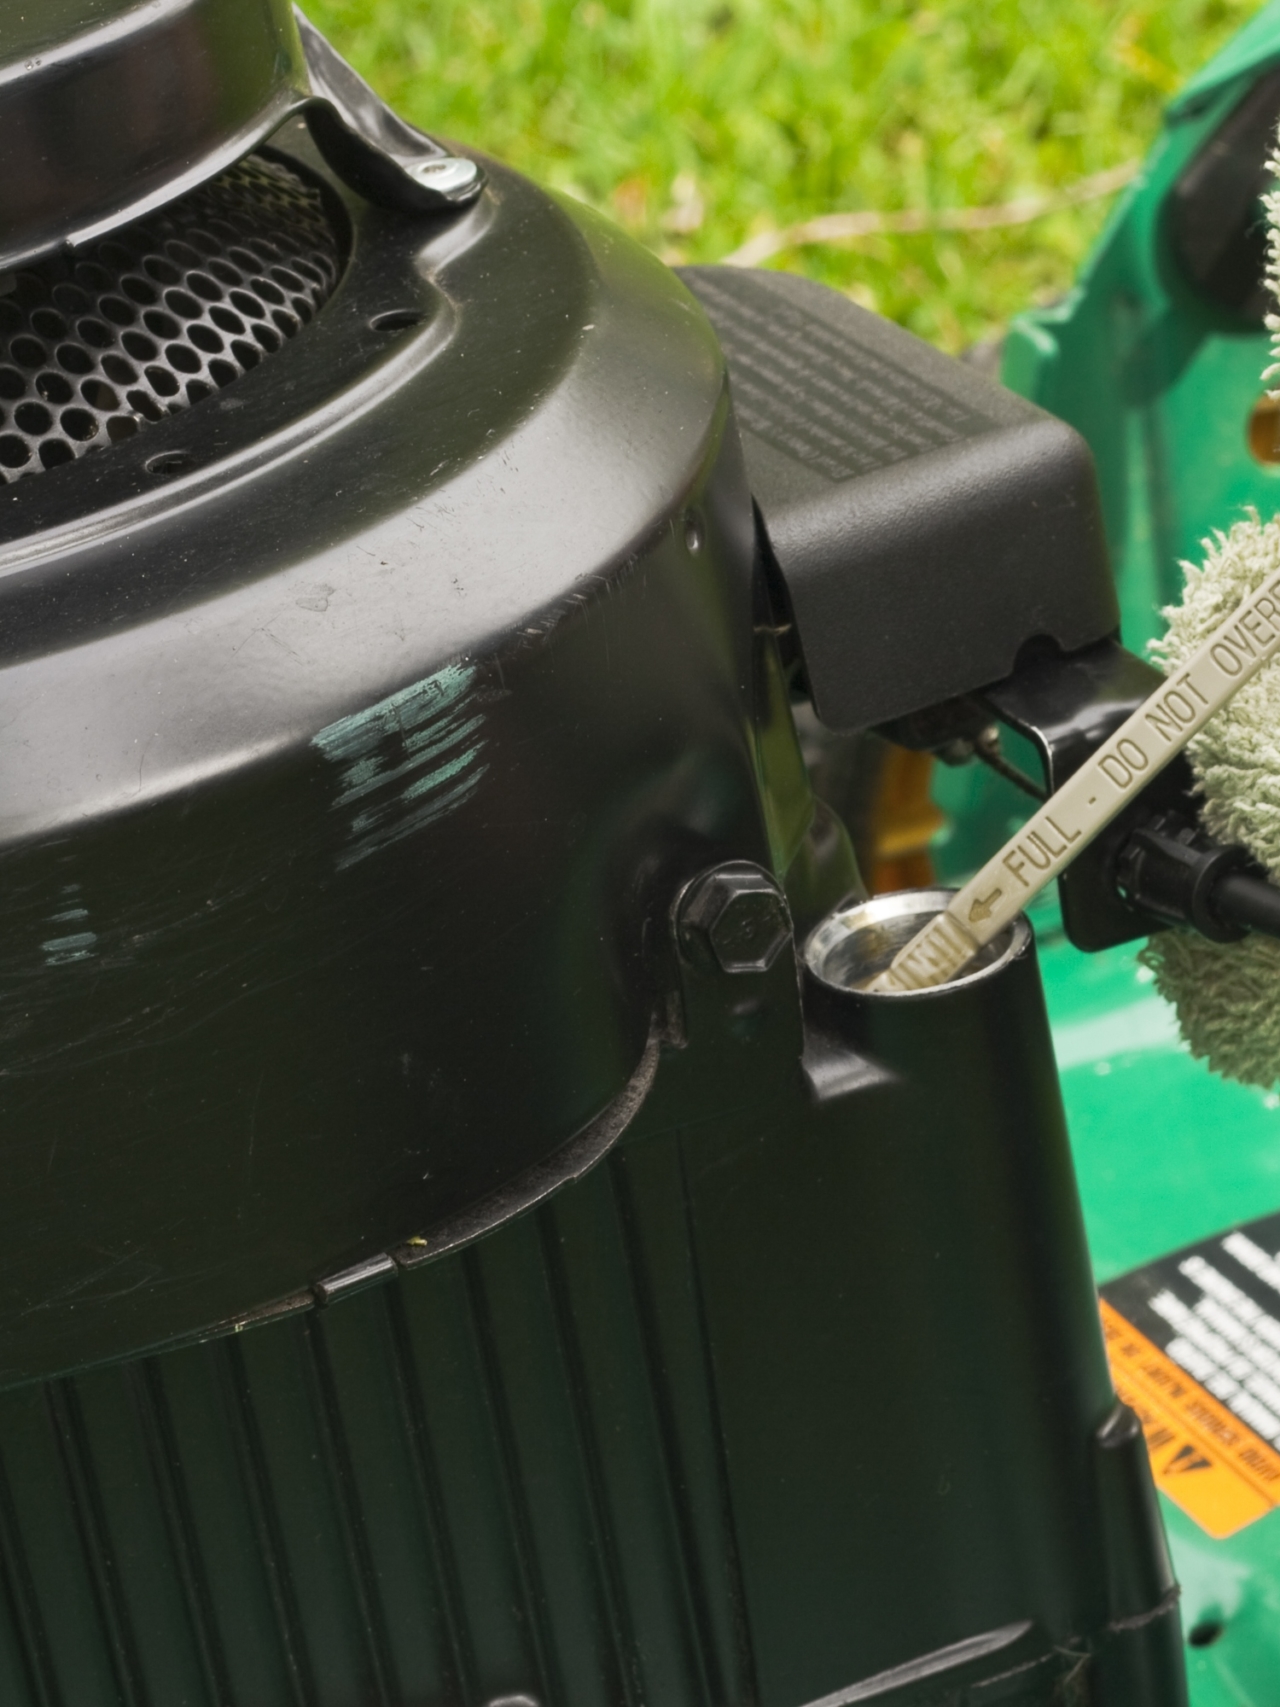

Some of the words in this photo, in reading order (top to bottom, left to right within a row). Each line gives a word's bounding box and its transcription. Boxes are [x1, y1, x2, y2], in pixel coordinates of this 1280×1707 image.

[1002, 815, 1082, 888] FULL
[1097, 738, 1150, 791] DO
[1145, 672, 1211, 742] NOT
